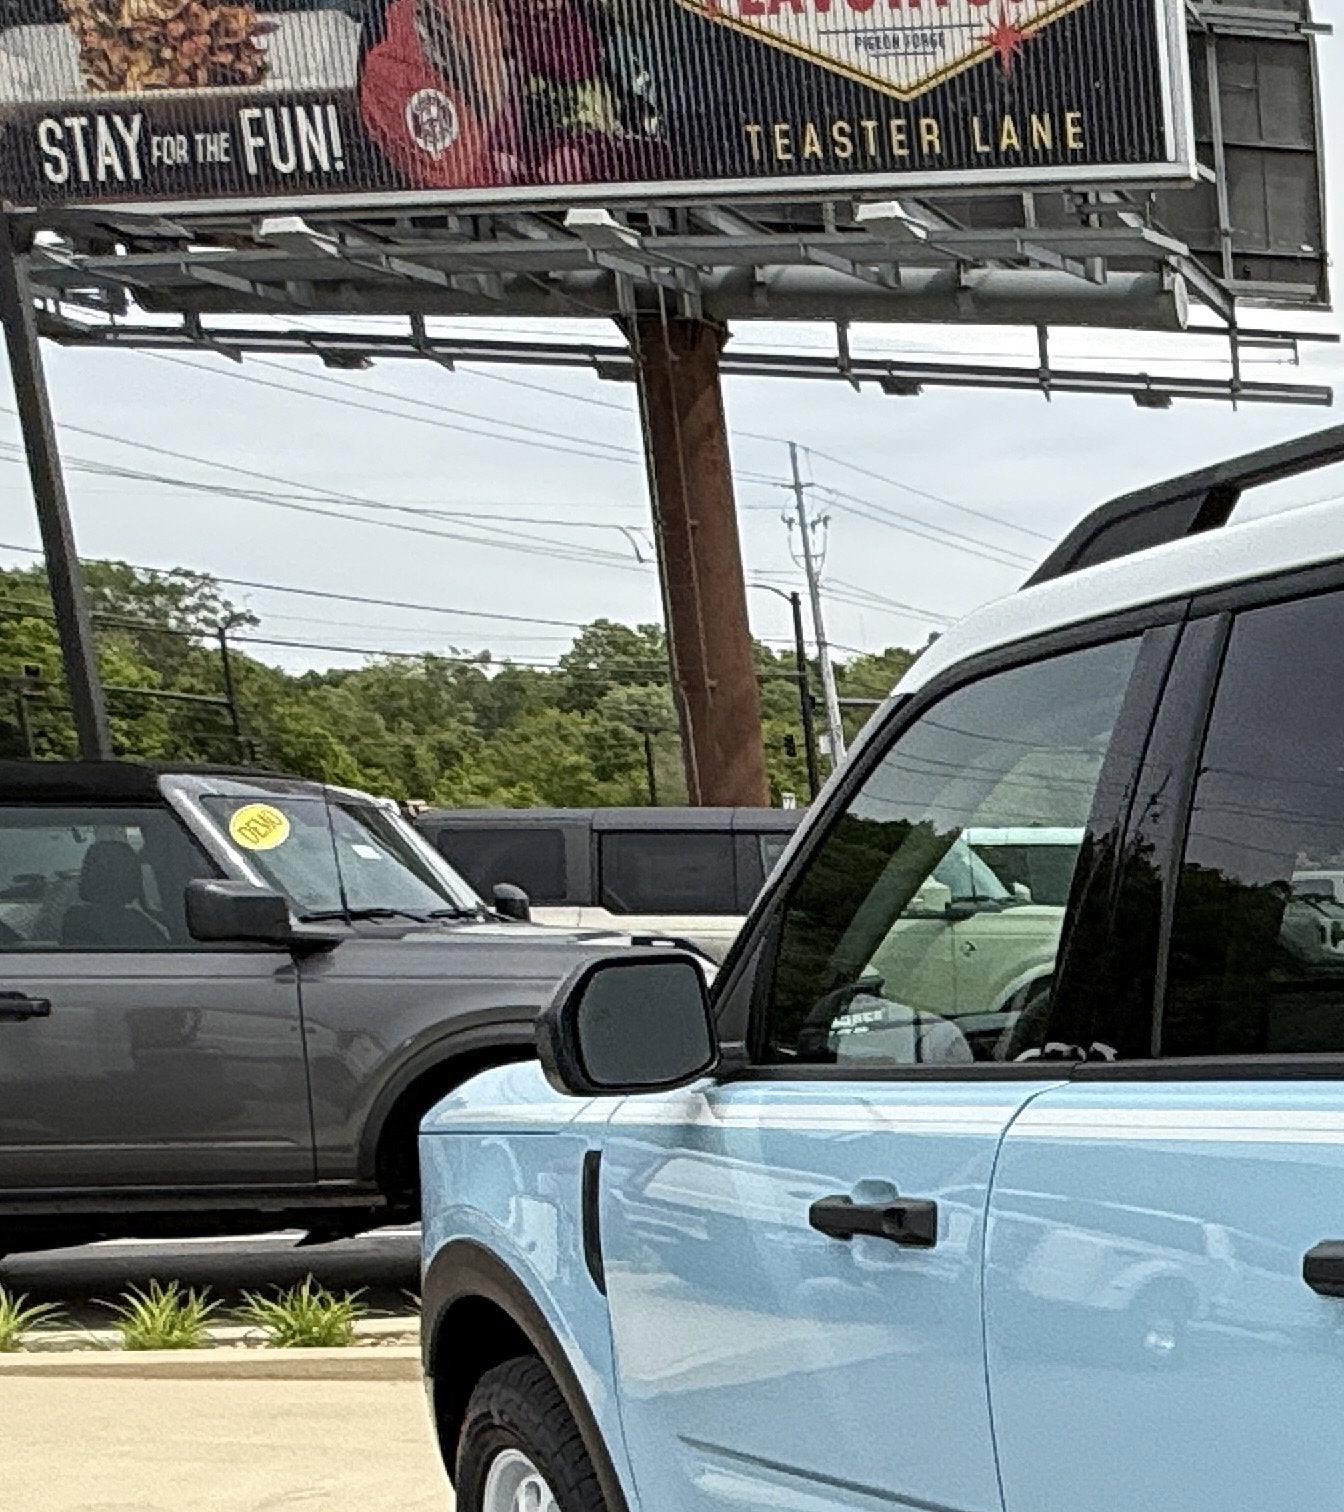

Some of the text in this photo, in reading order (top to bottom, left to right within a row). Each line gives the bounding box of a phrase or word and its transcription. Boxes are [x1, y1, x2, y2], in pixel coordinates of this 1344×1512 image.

[37, 104, 345, 184] STAY FOR THE FUN!
[746, 112, 1083, 160] TEASTER LANE
[237, 810, 282, 844] DEMO
